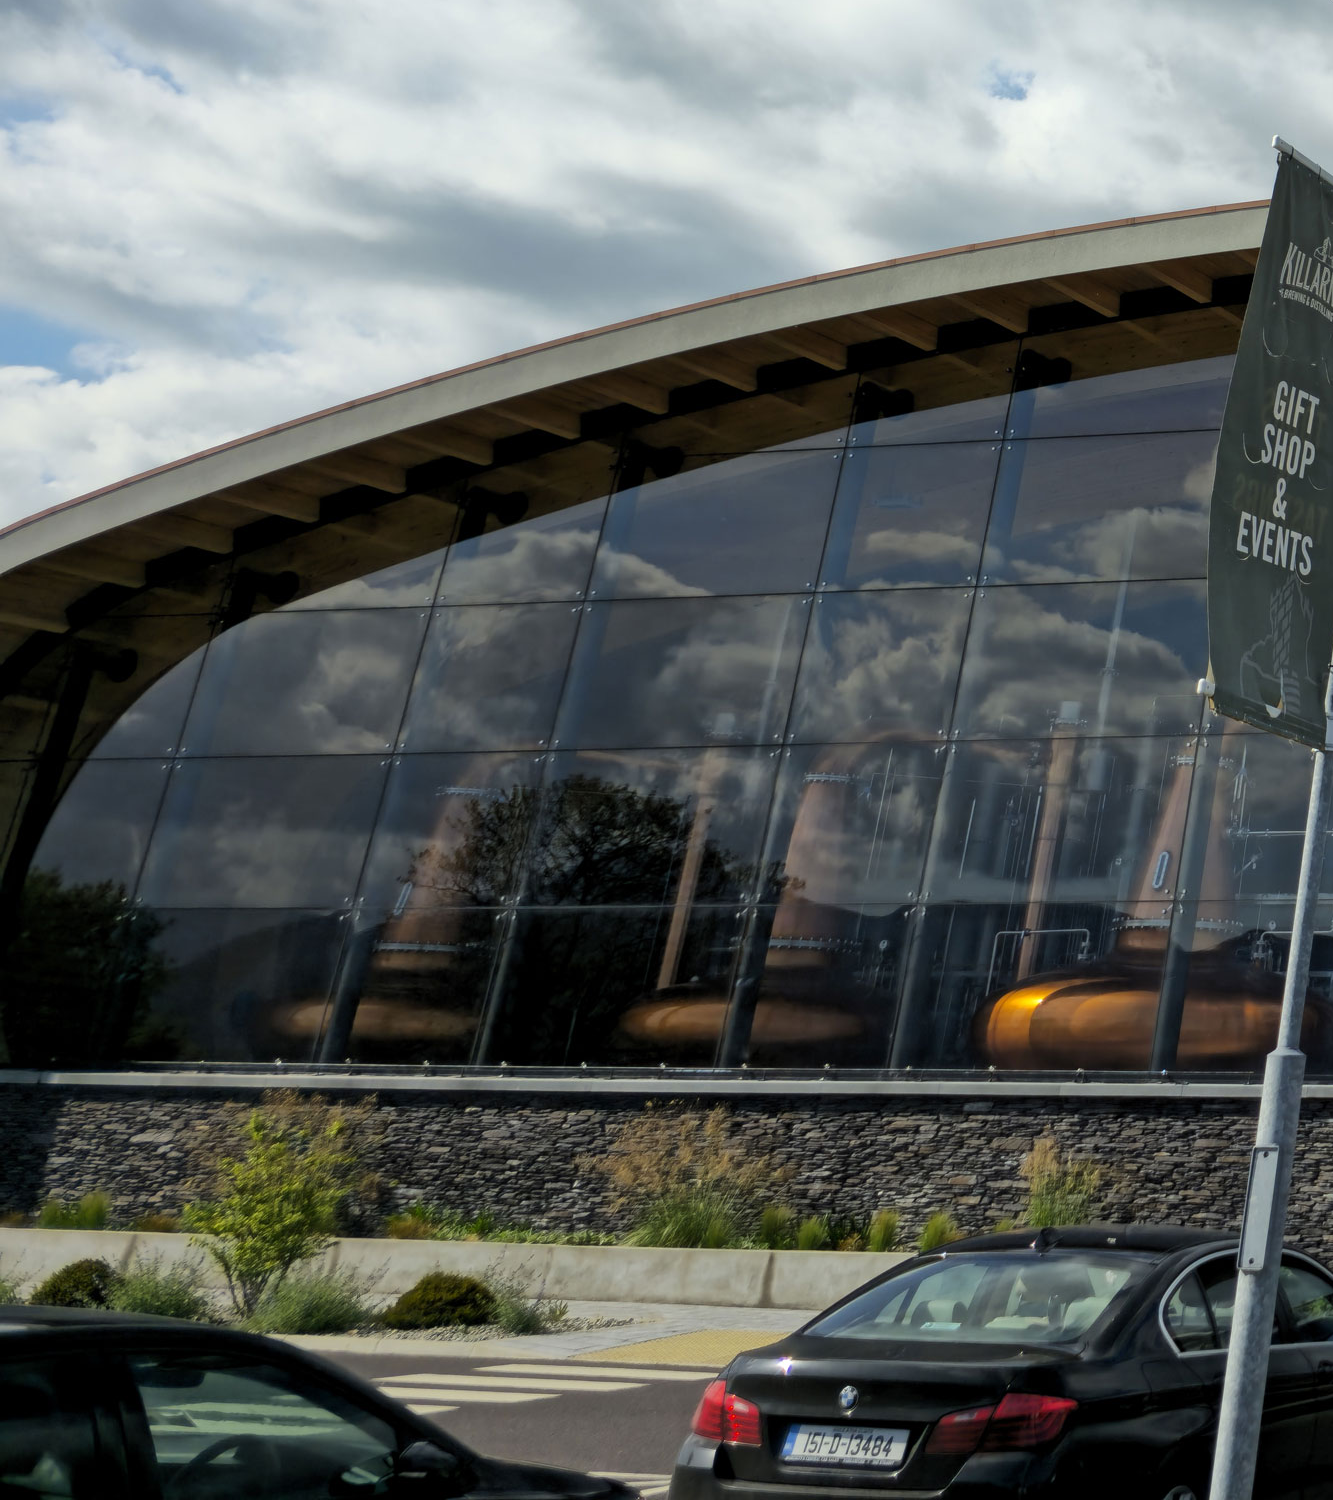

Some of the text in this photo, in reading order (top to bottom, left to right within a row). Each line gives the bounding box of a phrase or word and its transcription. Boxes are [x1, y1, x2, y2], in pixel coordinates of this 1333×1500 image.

[1283, 289, 1306, 304] BREWING
[1273, 380, 1320, 435] GIFT
[1261, 423, 1316, 480] SHOP
[1272, 477, 1287, 520] &
[1236, 510, 1313, 577] EVENTS
[803, 1430, 895, 1458] 151-D-13484
